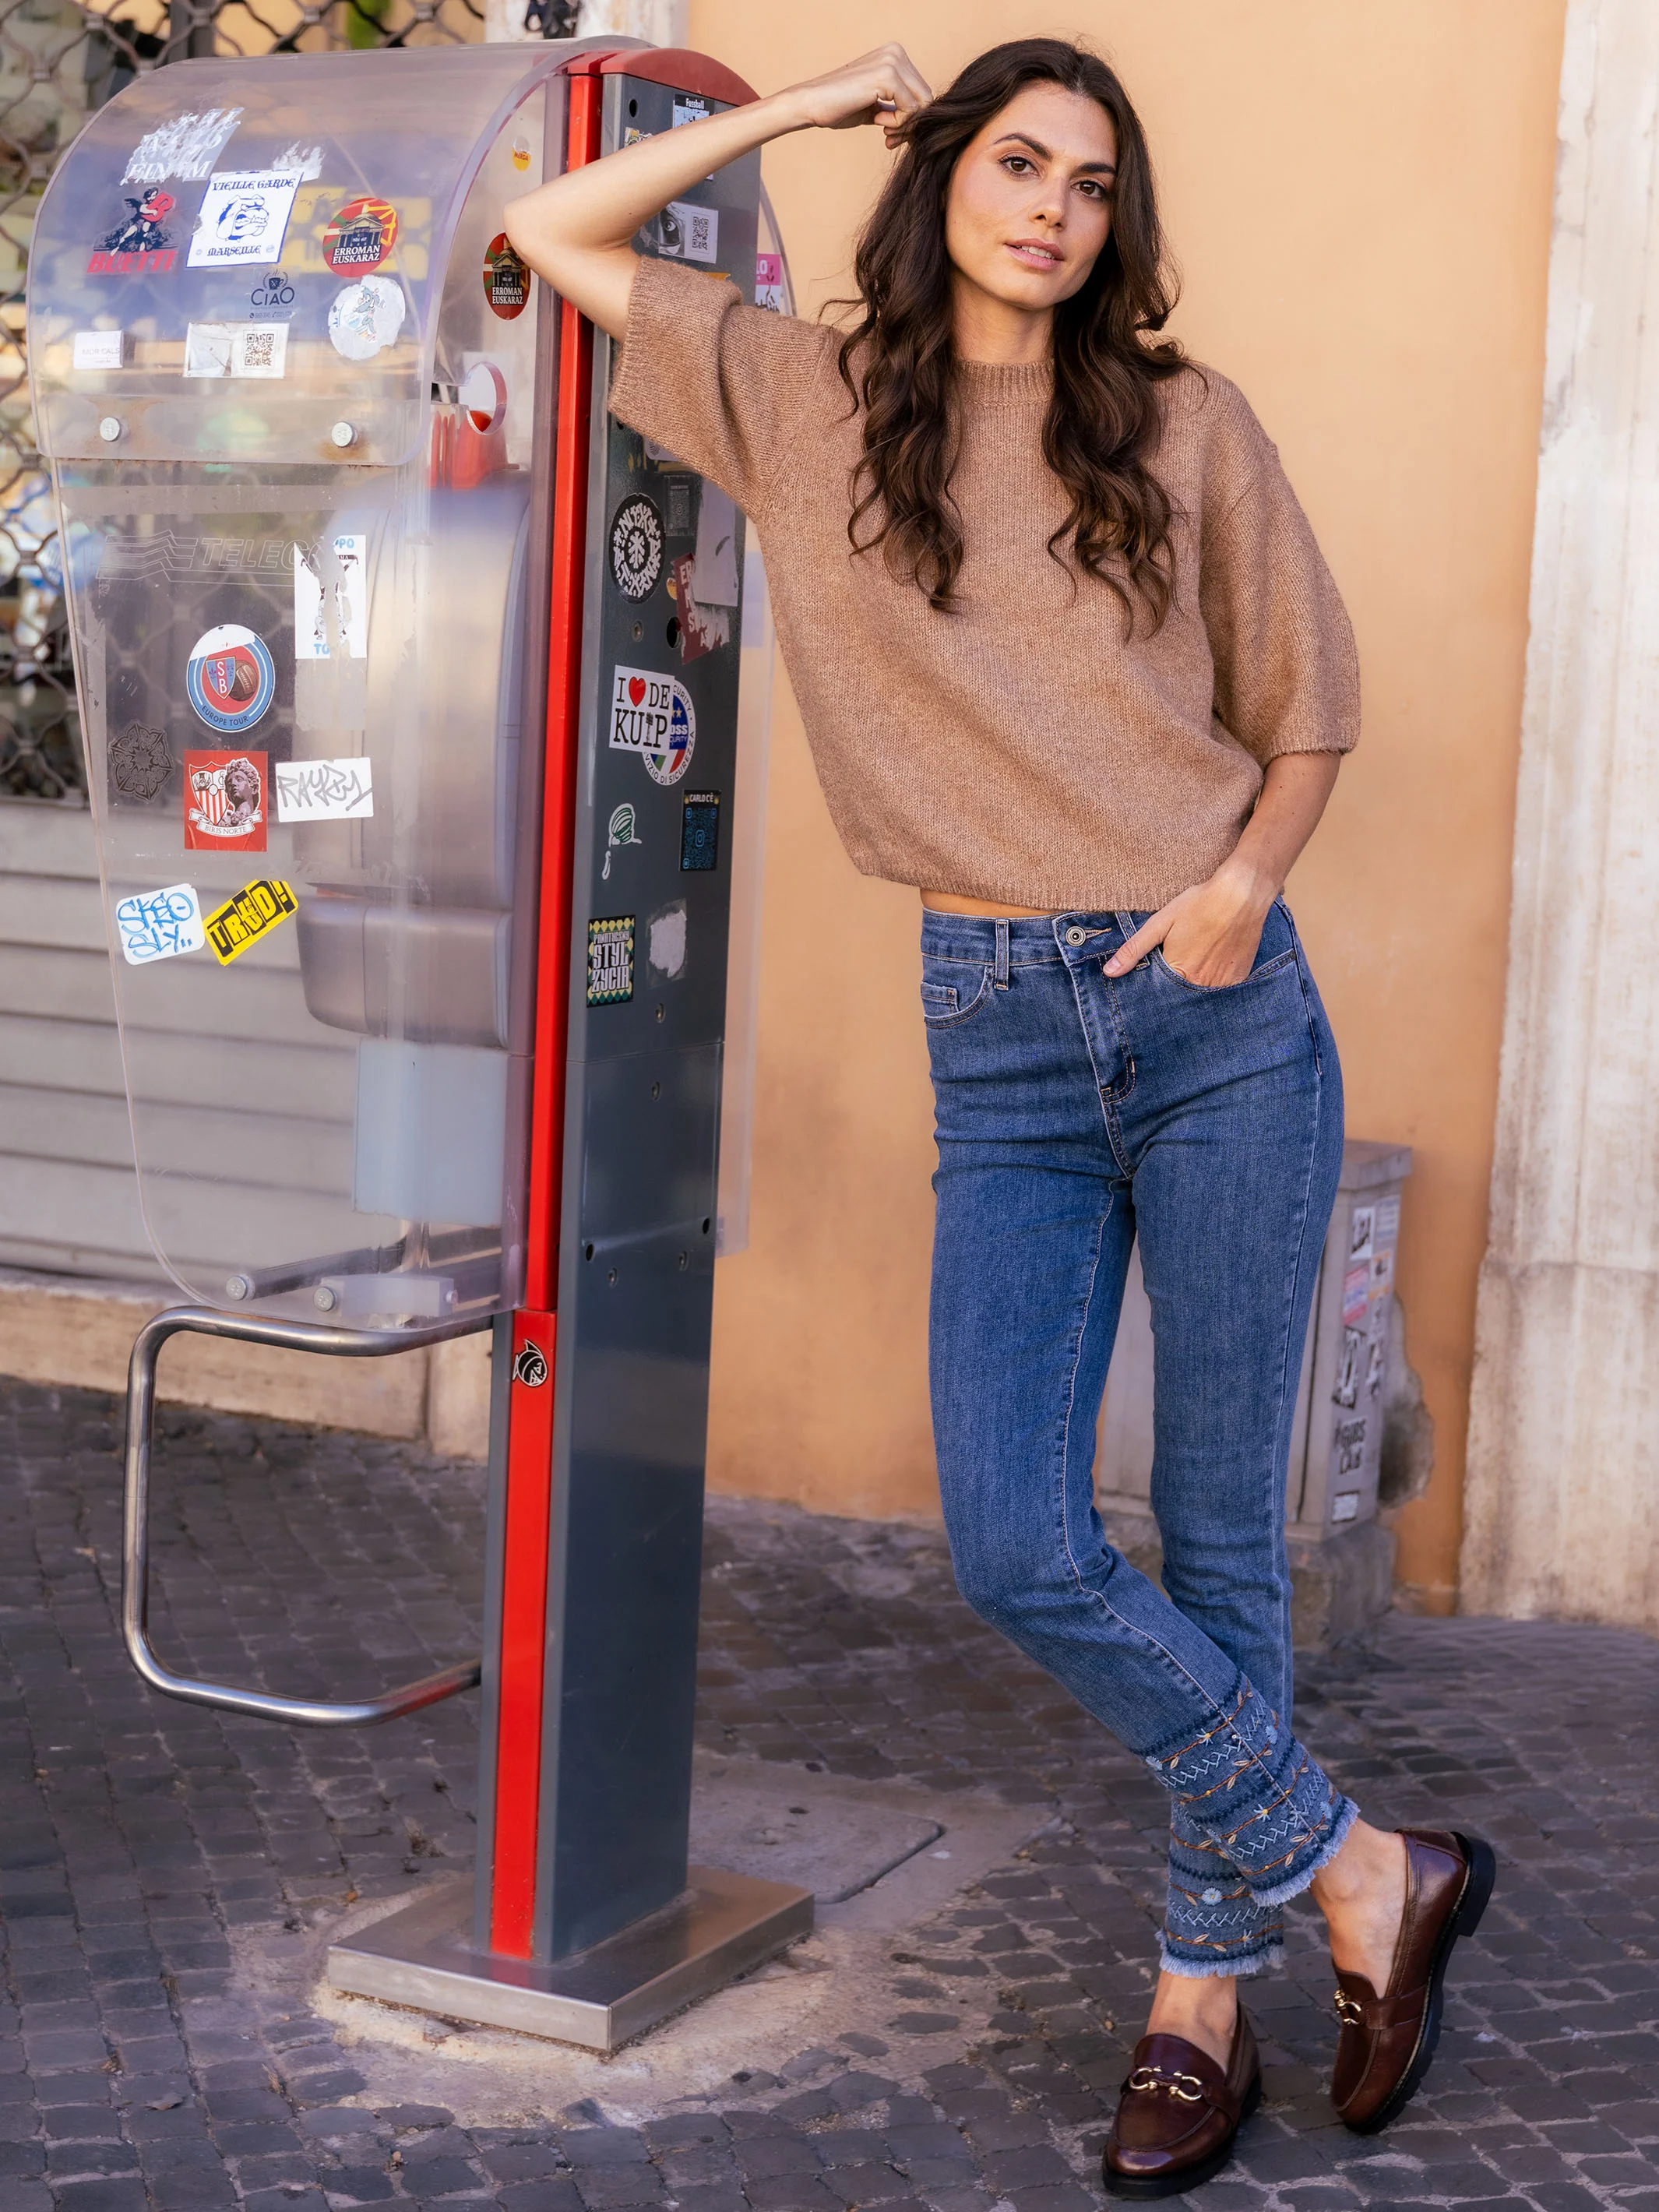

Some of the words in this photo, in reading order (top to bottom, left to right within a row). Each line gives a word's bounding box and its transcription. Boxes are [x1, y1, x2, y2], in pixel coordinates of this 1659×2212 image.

[212, 180, 255, 192] VIEILLE
[206, 245, 262, 257] MARSEILLE
[333, 245, 381, 256] ERROMAN
[86, 250, 178, 273] BUETTI
[332, 253, 381, 265] EUSKARAZ
[251, 286, 295, 306] CIAO
[491, 287, 523, 296] ERROMAN
[491, 296, 523, 305] EUSKARAZ
[217, 661, 225, 677] S
[219, 678, 227, 694] B
[616, 677, 626, 703] I
[648, 682, 671, 710] DE
[201, 705, 227, 726] EUROPE
[229, 716, 249, 727] TOUR
[613, 708, 668, 748] KUIP
[643, 752, 660, 780] VIZIO
[689, 794, 706, 803] CARLO
[204, 826, 223, 834] BIRIS
[223, 826, 247, 835] NORTE
[593, 941, 630, 970] STYL
